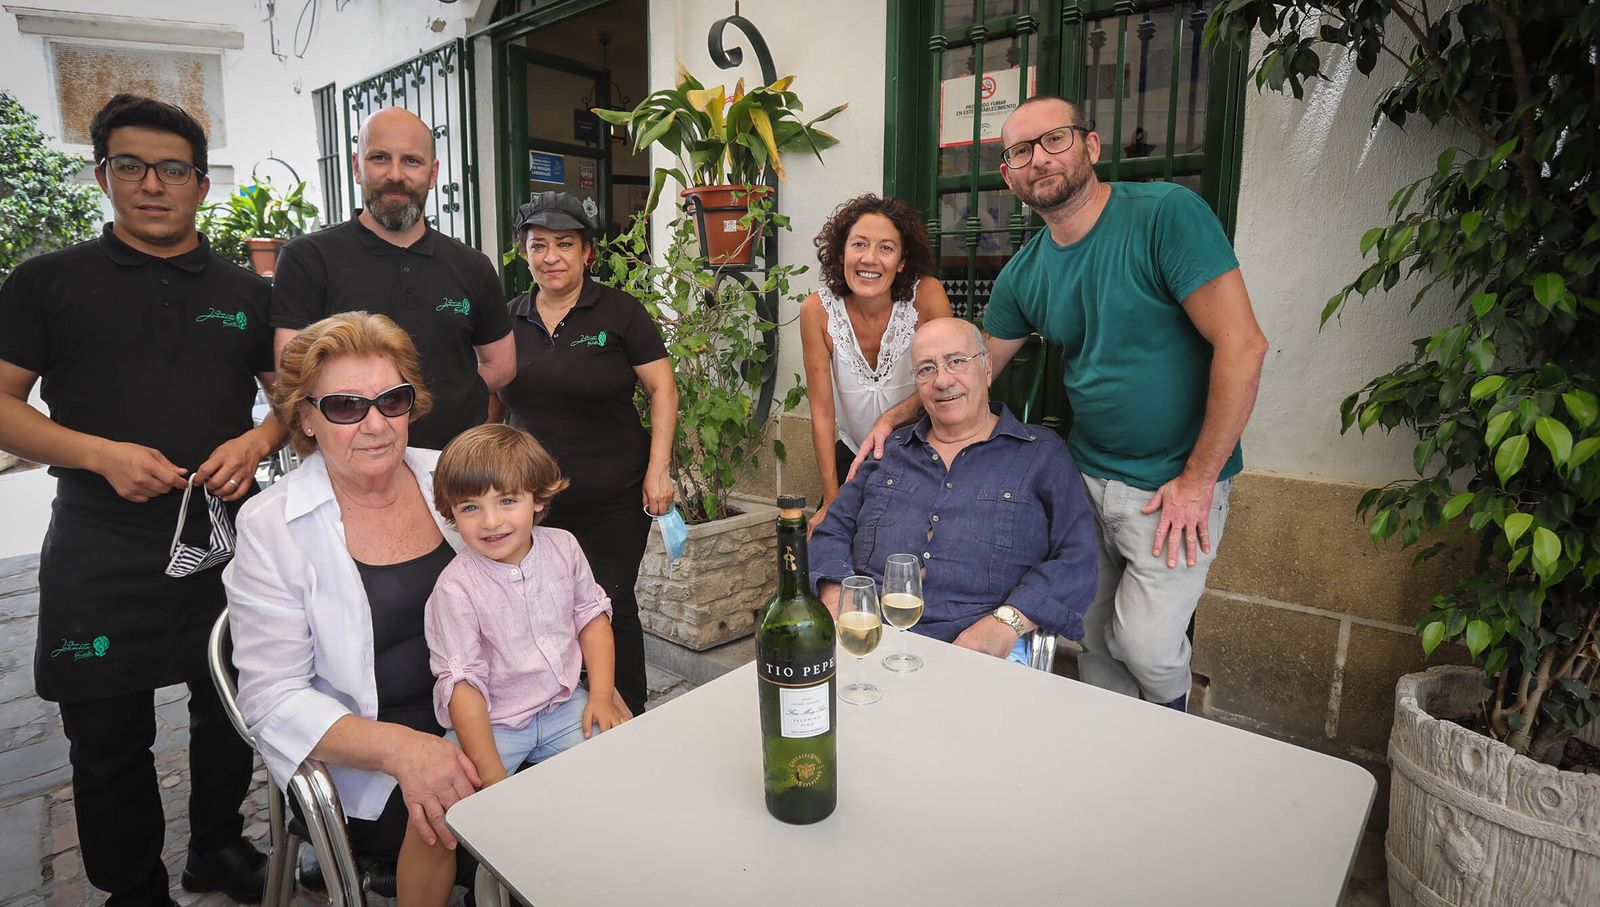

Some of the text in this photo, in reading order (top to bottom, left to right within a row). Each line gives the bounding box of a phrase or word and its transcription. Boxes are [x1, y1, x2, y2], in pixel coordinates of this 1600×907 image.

[975, 103, 1017, 113] ABLECIMIENTO
[766, 657, 835, 677] TIO PEPE
